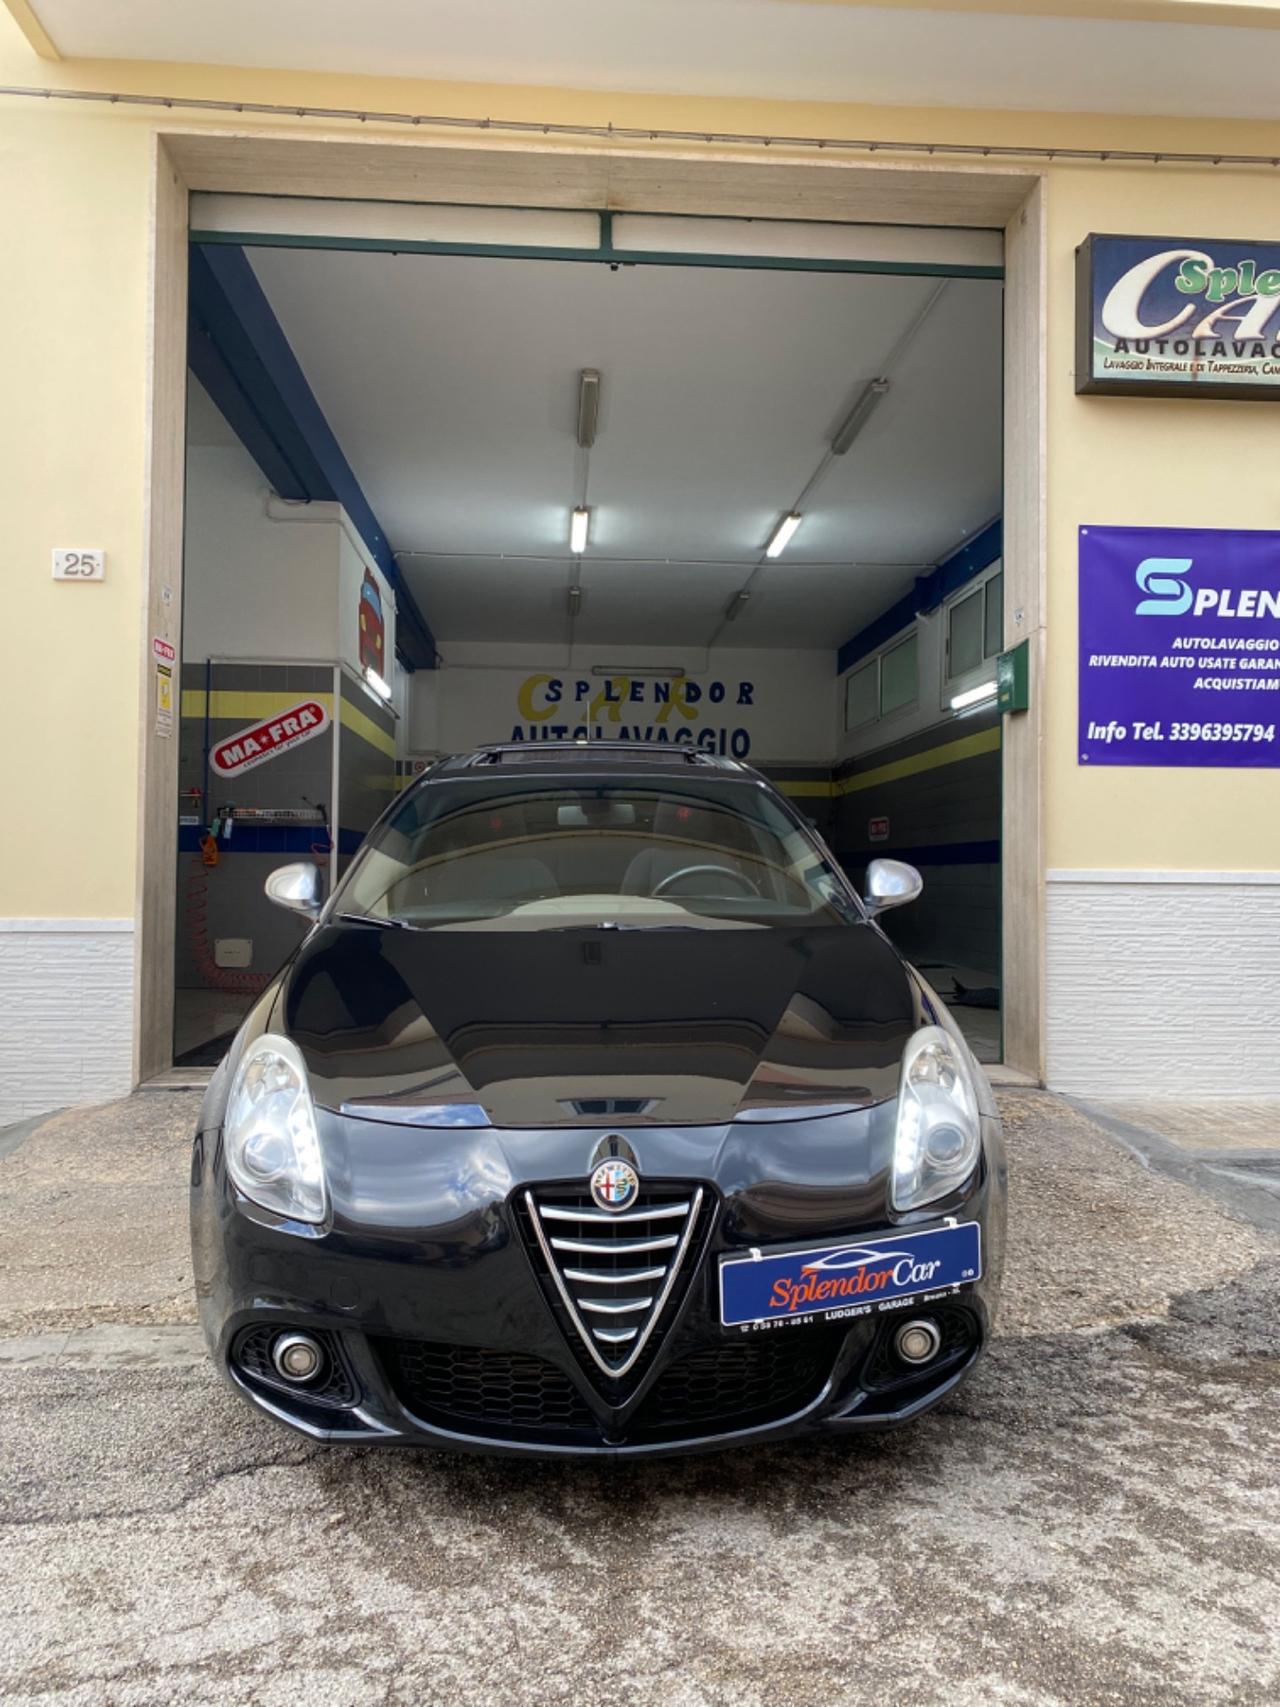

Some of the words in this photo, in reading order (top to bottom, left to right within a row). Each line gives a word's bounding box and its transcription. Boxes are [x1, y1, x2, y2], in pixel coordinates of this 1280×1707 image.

[1102, 249, 1280, 341] CA
[64, 553, 95, 577] 25
[1172, 637, 1279, 651] AUTOLAVAGGIO
[1089, 655, 1157, 668] RIVENDITA
[1160, 656, 1195, 669] AUTO
[1198, 657, 1237, 670] USATE
[545, 679, 754, 705] SPLENDOR
[1193, 677, 1280, 691] ACQUISTIAM
[1088, 721, 1127, 743] Info
[1132, 723, 1164, 741] Tel.
[1169, 723, 1275, 743] 3396395794
[824, 1305, 873, 1321] LUDGER'S
[878, 1297, 915, 1311] GARAGE
